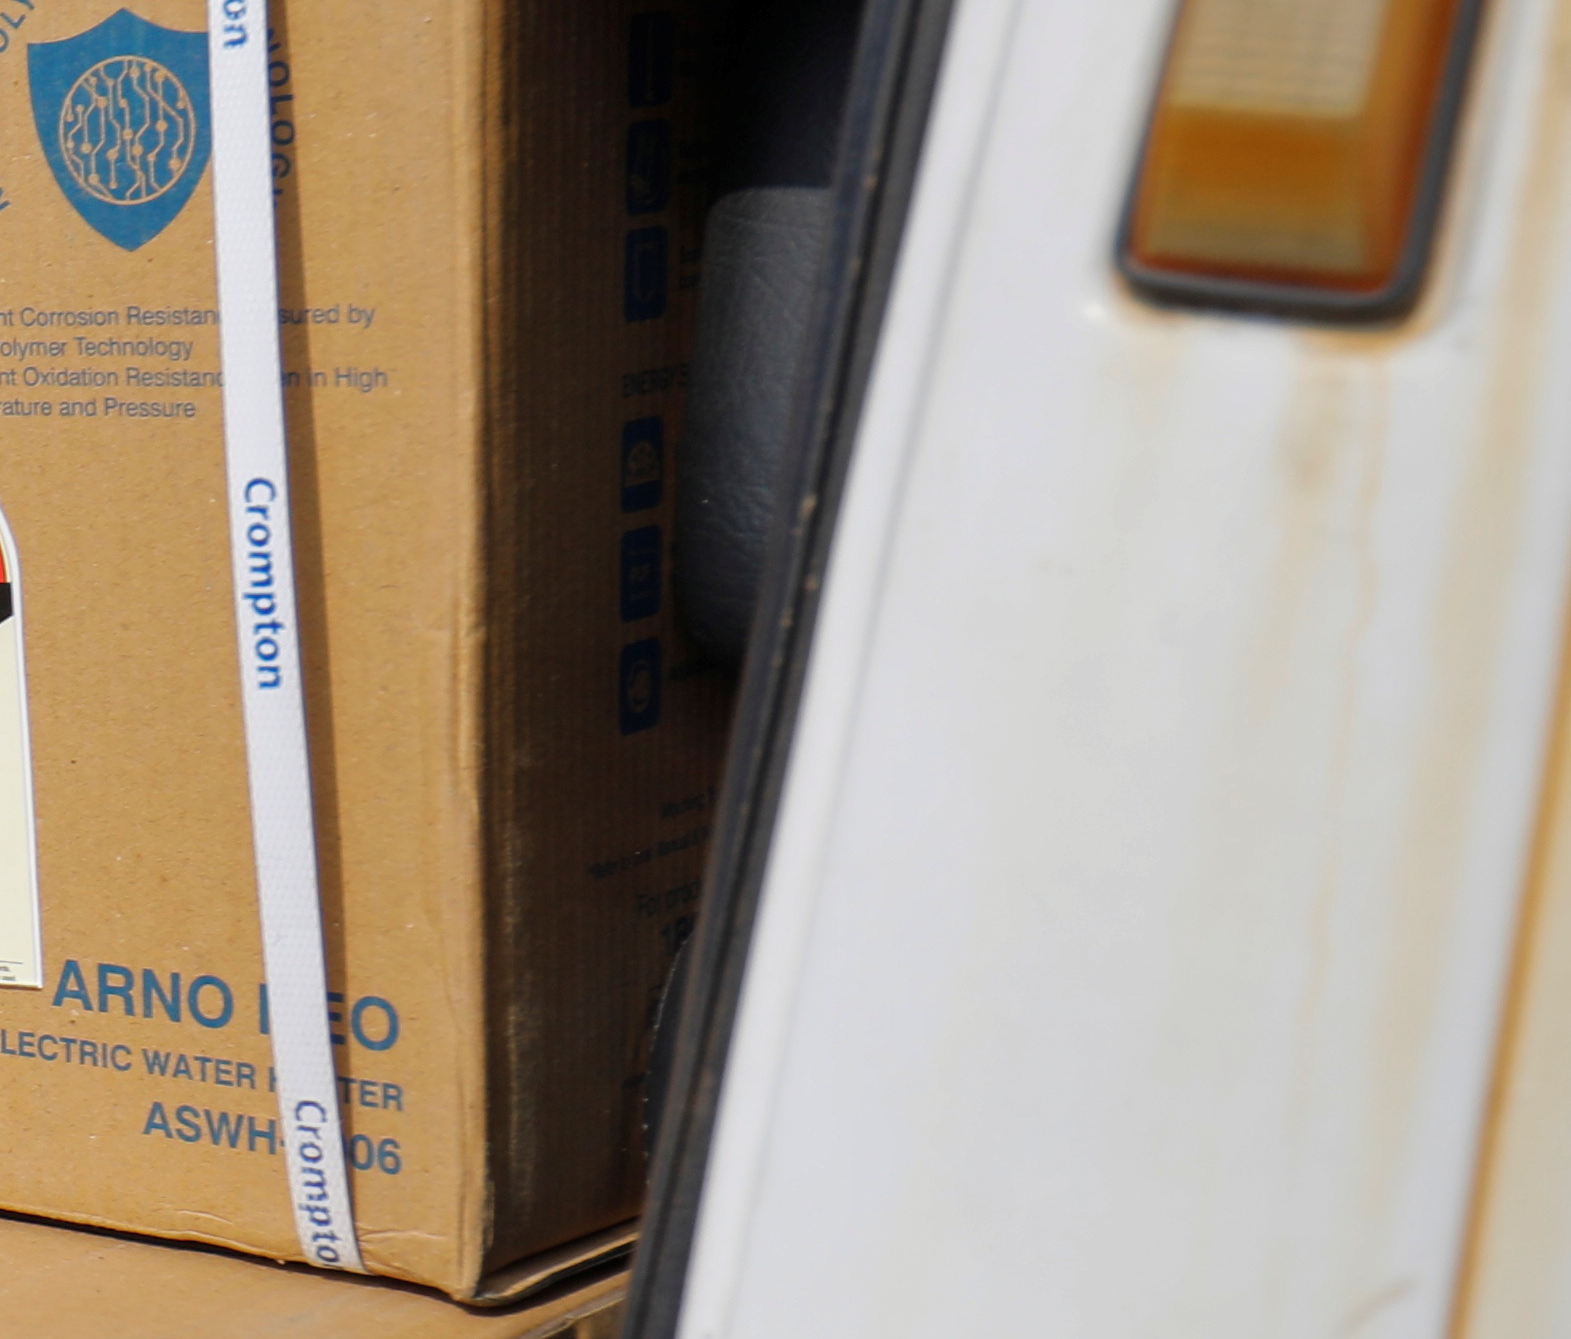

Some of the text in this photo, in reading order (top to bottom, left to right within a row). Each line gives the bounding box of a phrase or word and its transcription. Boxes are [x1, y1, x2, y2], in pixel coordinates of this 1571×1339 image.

[20, 308, 120, 327] Corrosion
[126, 308, 223, 327] Resistan
[348, 304, 375, 327] by
[75, 337, 193, 359] Technology
[23, 367, 119, 387] Oxidation
[125, 367, 225, 387] Resistanc
[335, 368, 387, 392] High
[59, 398, 96, 416] and
[104, 399, 195, 417] Pressure
[243, 478, 286, 690] Crompton
[53, 960, 234, 1028] ARNO
[142, 1048, 255, 1089] WATER
[293, 1099, 343, 1269] Crompto
